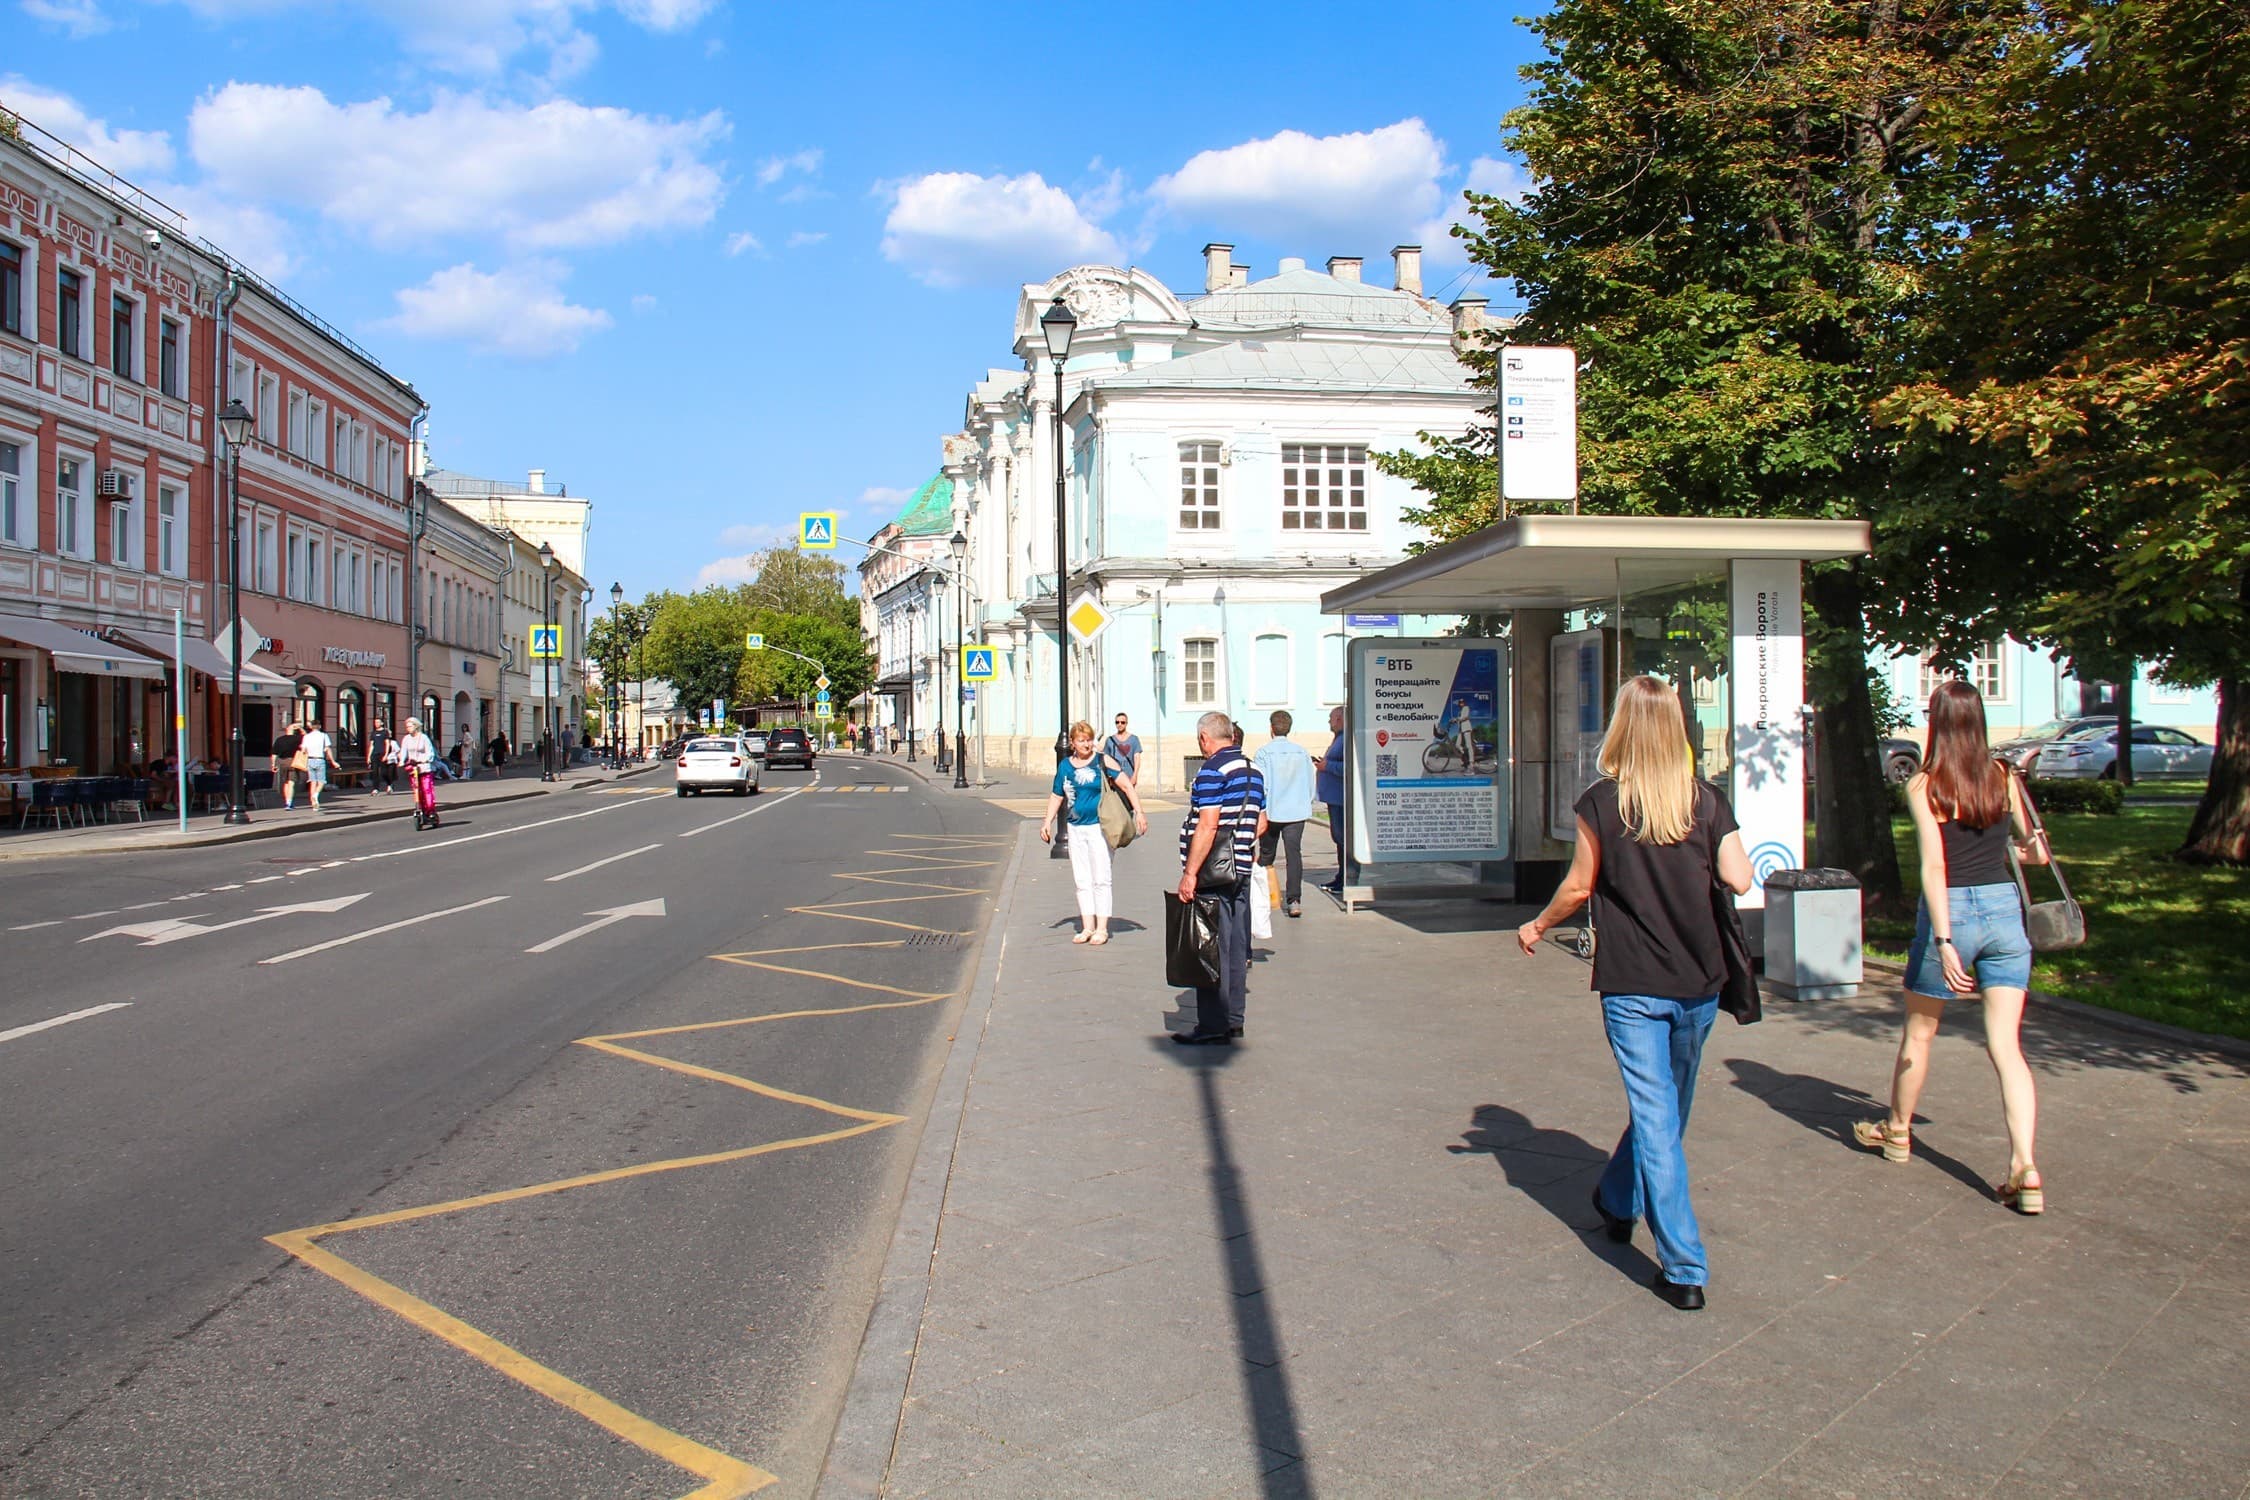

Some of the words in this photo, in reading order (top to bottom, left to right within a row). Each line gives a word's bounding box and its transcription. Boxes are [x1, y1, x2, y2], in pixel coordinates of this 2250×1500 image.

[1770, 591, 1778, 622] Vorota
[1756, 591, 1769, 641] Ворота
[1387, 659, 1413, 671] ВТБ
[1375, 677, 1441, 688] Превращайте
[1756, 645, 1769, 730] Покровские
[1375, 689, 1412, 699] бонусы
[1383, 703, 1424, 711] поездки
[1375, 714, 1381, 722] с
[1382, 712, 1439, 722] «Велобайк»
